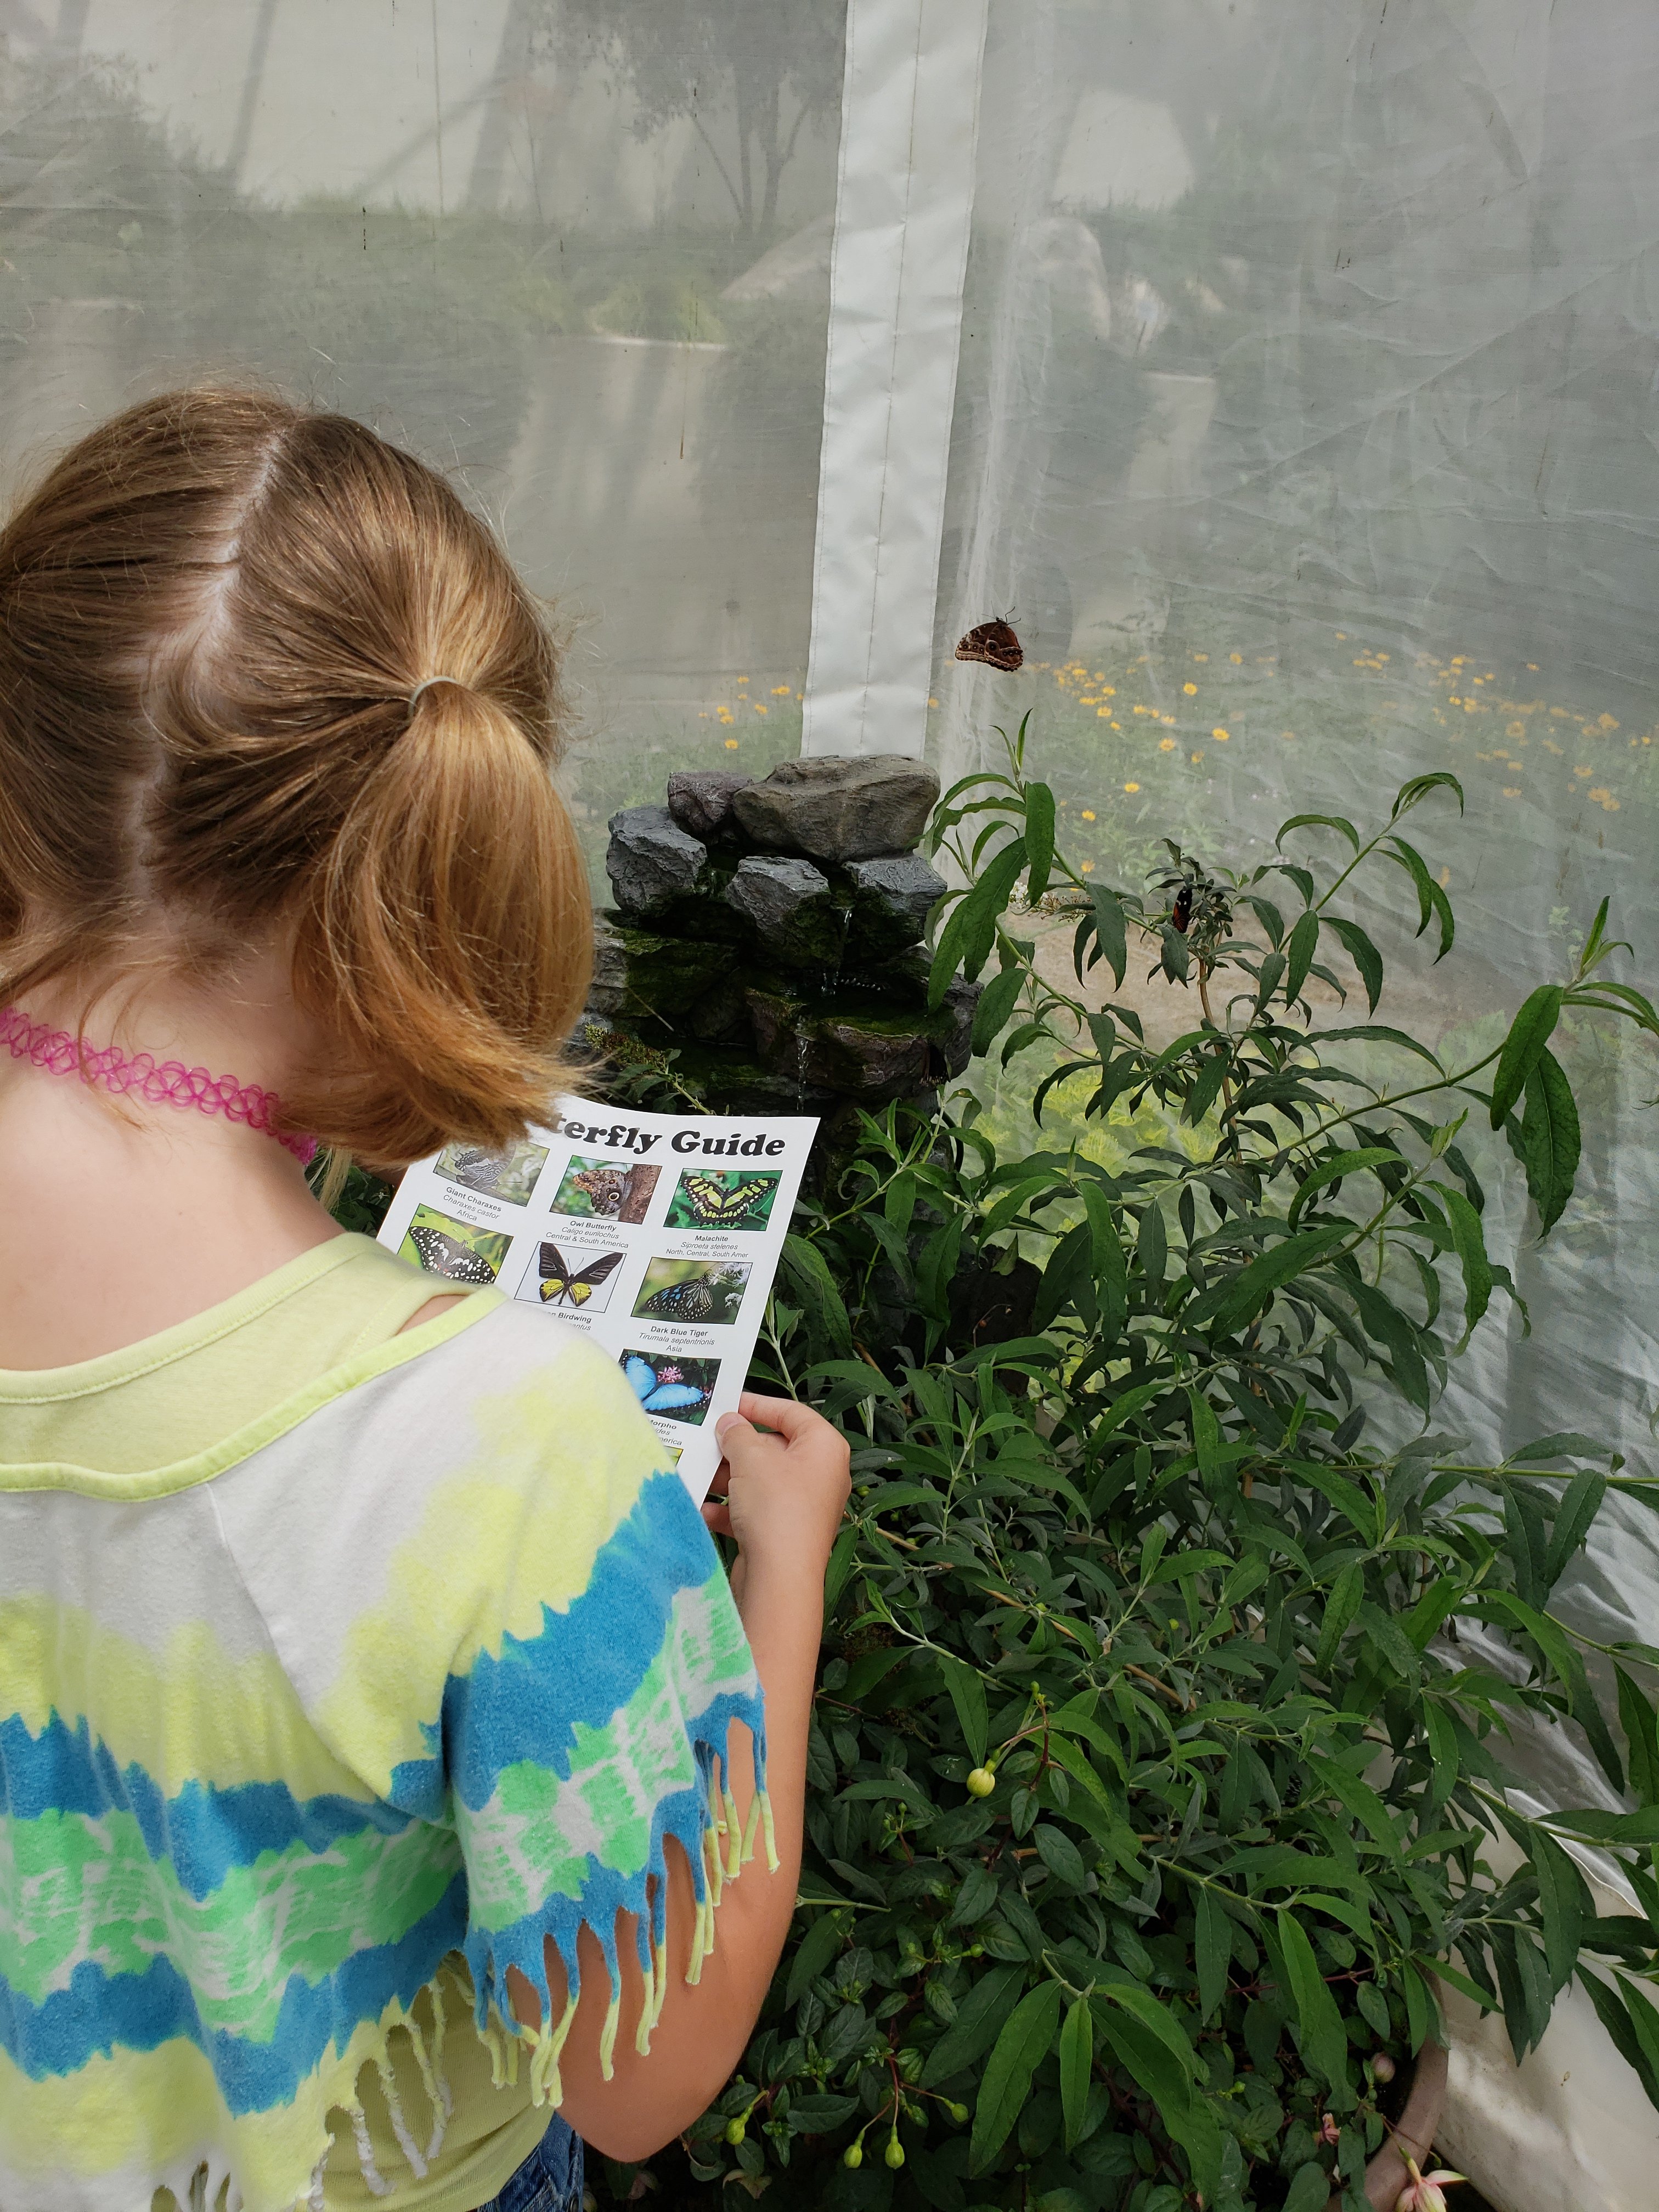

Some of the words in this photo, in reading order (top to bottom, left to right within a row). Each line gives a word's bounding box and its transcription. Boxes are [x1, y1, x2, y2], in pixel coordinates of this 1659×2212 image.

[549, 1112, 662, 1155] terfly
[671, 1130, 786, 1156] Guide
[446, 1187, 466, 1199] Giant
[467, 1195, 501, 1212] Charaxes
[443, 1194, 476, 1211] Charaxes
[477, 1209, 500, 1219] castor
[456, 1209, 477, 1221] Africa
[562, 1227, 583, 1235] Caligo
[585, 1222, 617, 1232] Butterfly
[546, 1232, 571, 1241] Central
[600, 1239, 629, 1248] America
[558, 1312, 592, 1324] Birdwing
[639, 1333, 669, 1342] Tirumala
[690, 1329, 708, 1338] Tiger
[659, 1437, 682, 1446] erica
